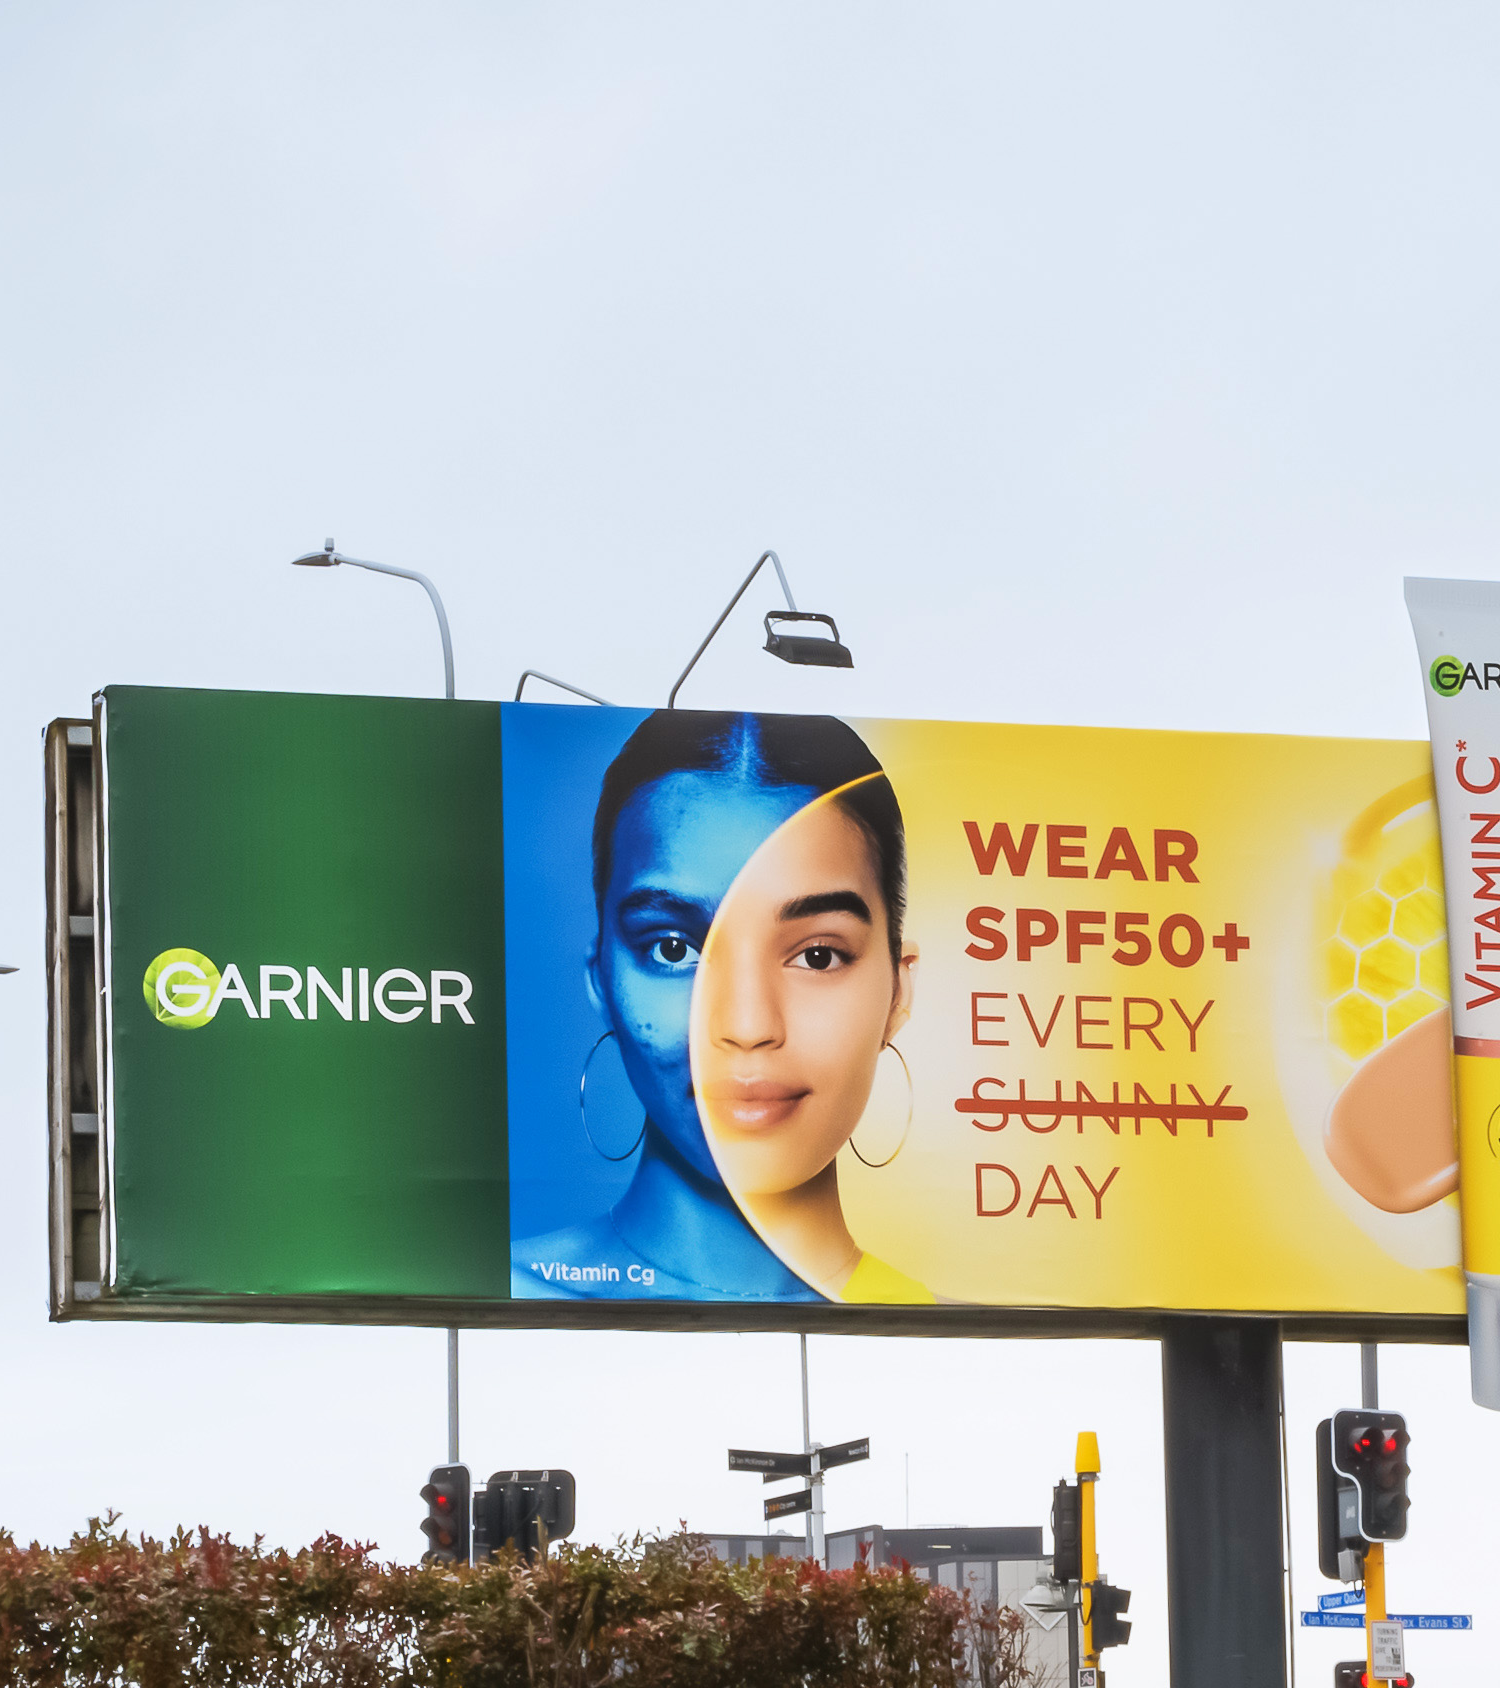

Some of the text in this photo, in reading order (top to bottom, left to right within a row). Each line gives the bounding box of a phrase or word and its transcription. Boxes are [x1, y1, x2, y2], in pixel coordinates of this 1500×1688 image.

[962, 821, 1200, 883] WEAR
[964, 906, 1250, 968] SPF50+
[155, 960, 475, 1025] GARNIER
[971, 991, 1215, 1052] EVERY
[971, 1077, 1233, 1138] SUNNY
[975, 1163, 1121, 1219] DAY
[626, 1264, 655, 1286] Cg
[1309, 1616, 1320, 1625] Ian
[1323, 1616, 1359, 1626] McKinnon
[1323, 1595, 1343, 1608] Upper
[1419, 1616, 1448, 1628] Evans
[1452, 1616, 1464, 1628] St
